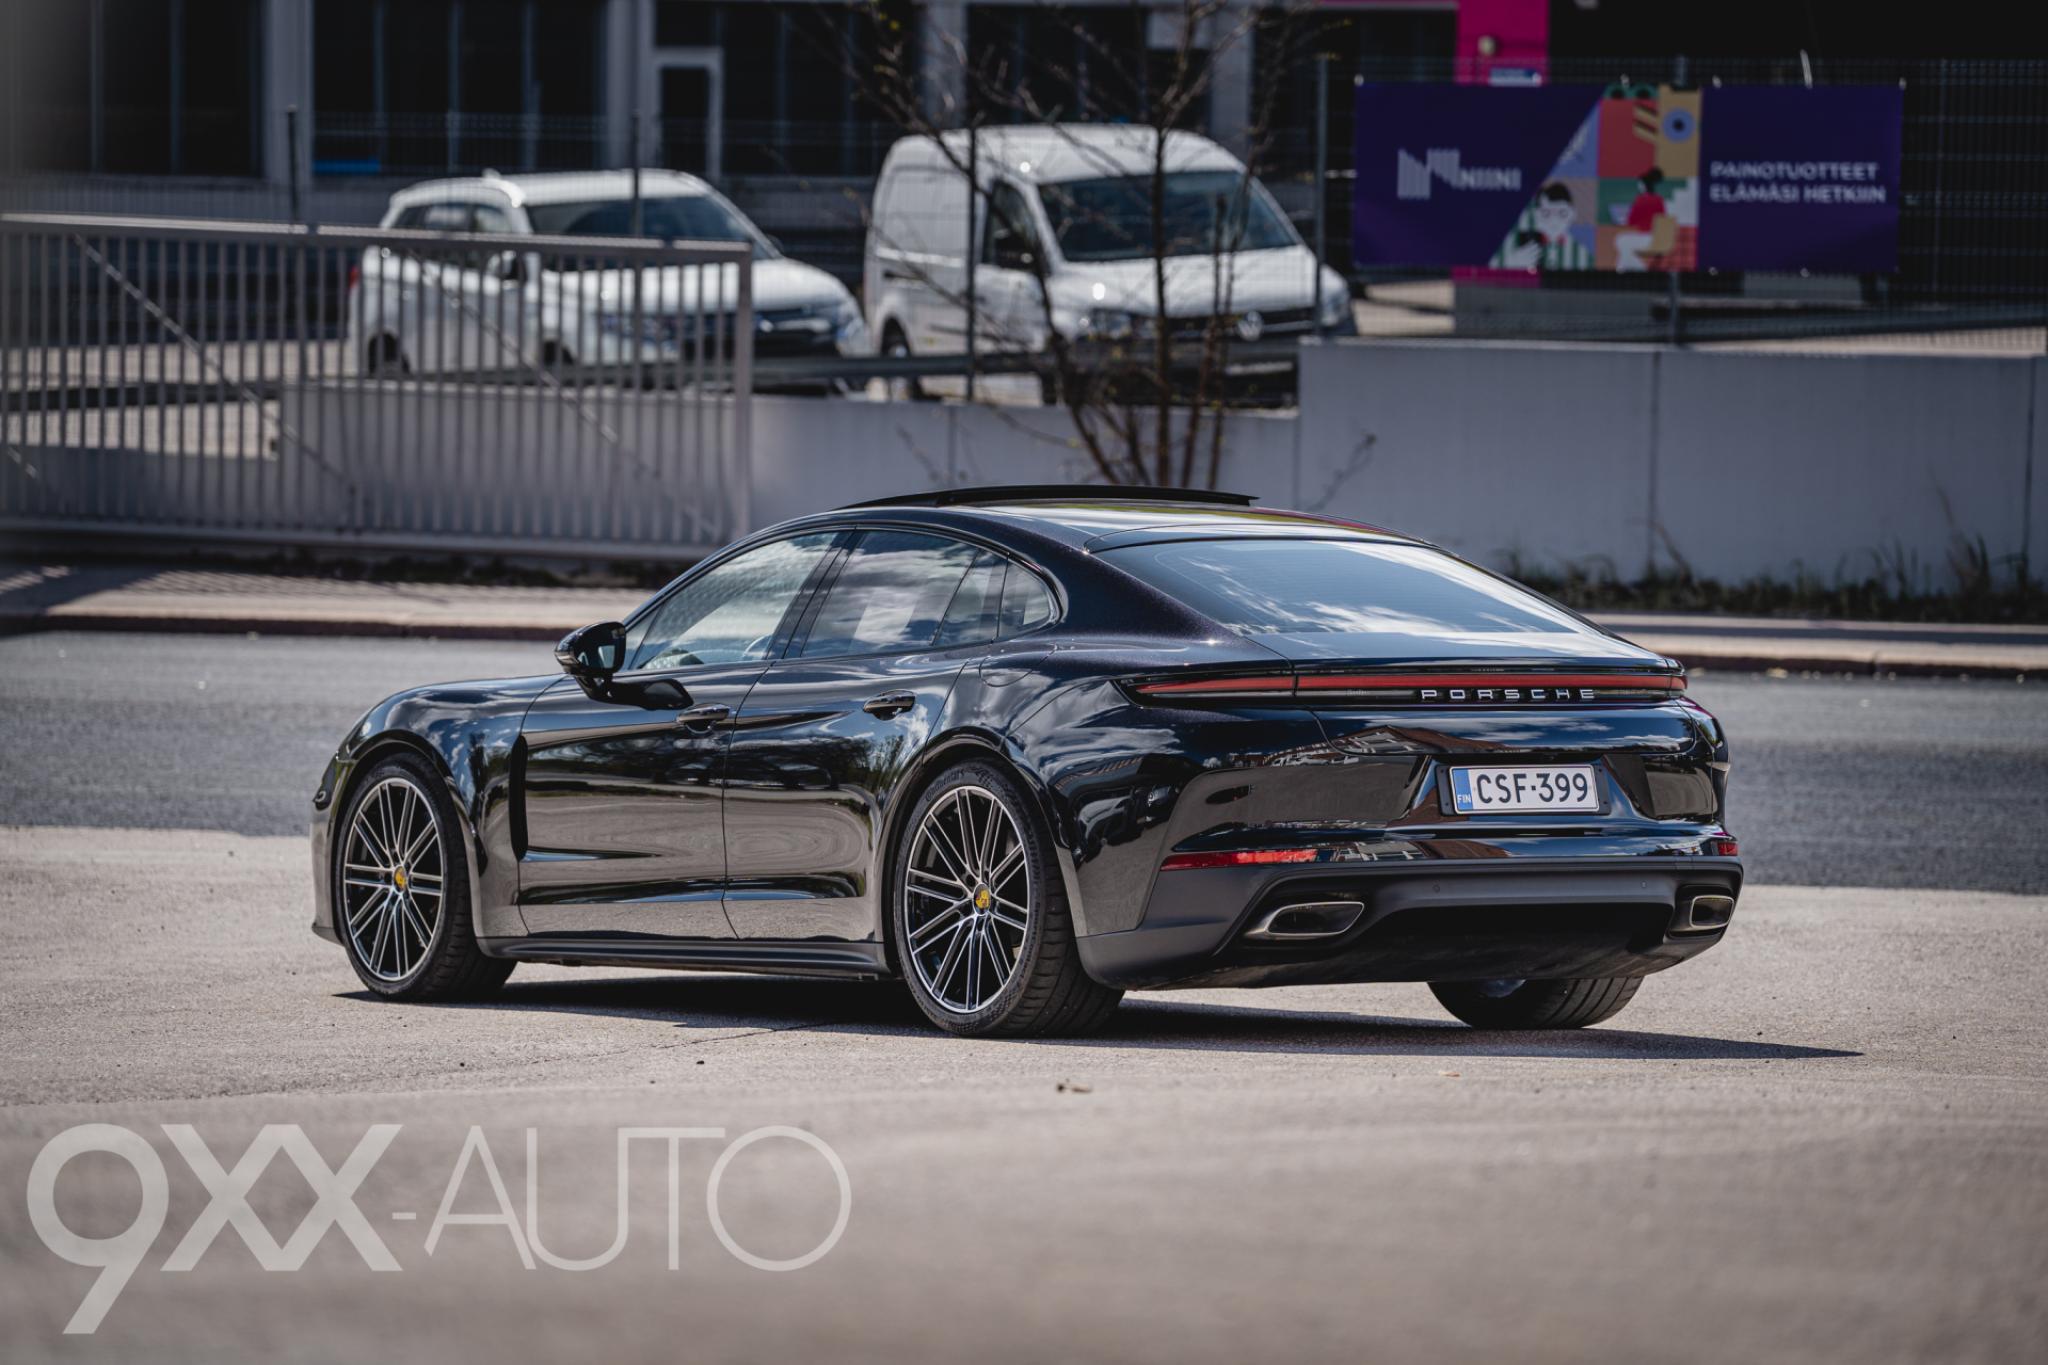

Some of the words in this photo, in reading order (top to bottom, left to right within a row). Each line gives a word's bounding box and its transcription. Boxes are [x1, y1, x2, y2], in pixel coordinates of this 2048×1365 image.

[1711, 162, 1877, 180] PAINOTUOTTEET
[1421, 689, 1595, 699] PORSCHE
[1457, 794, 1471, 803] FIN
[1477, 773, 1588, 803] CSF-399
